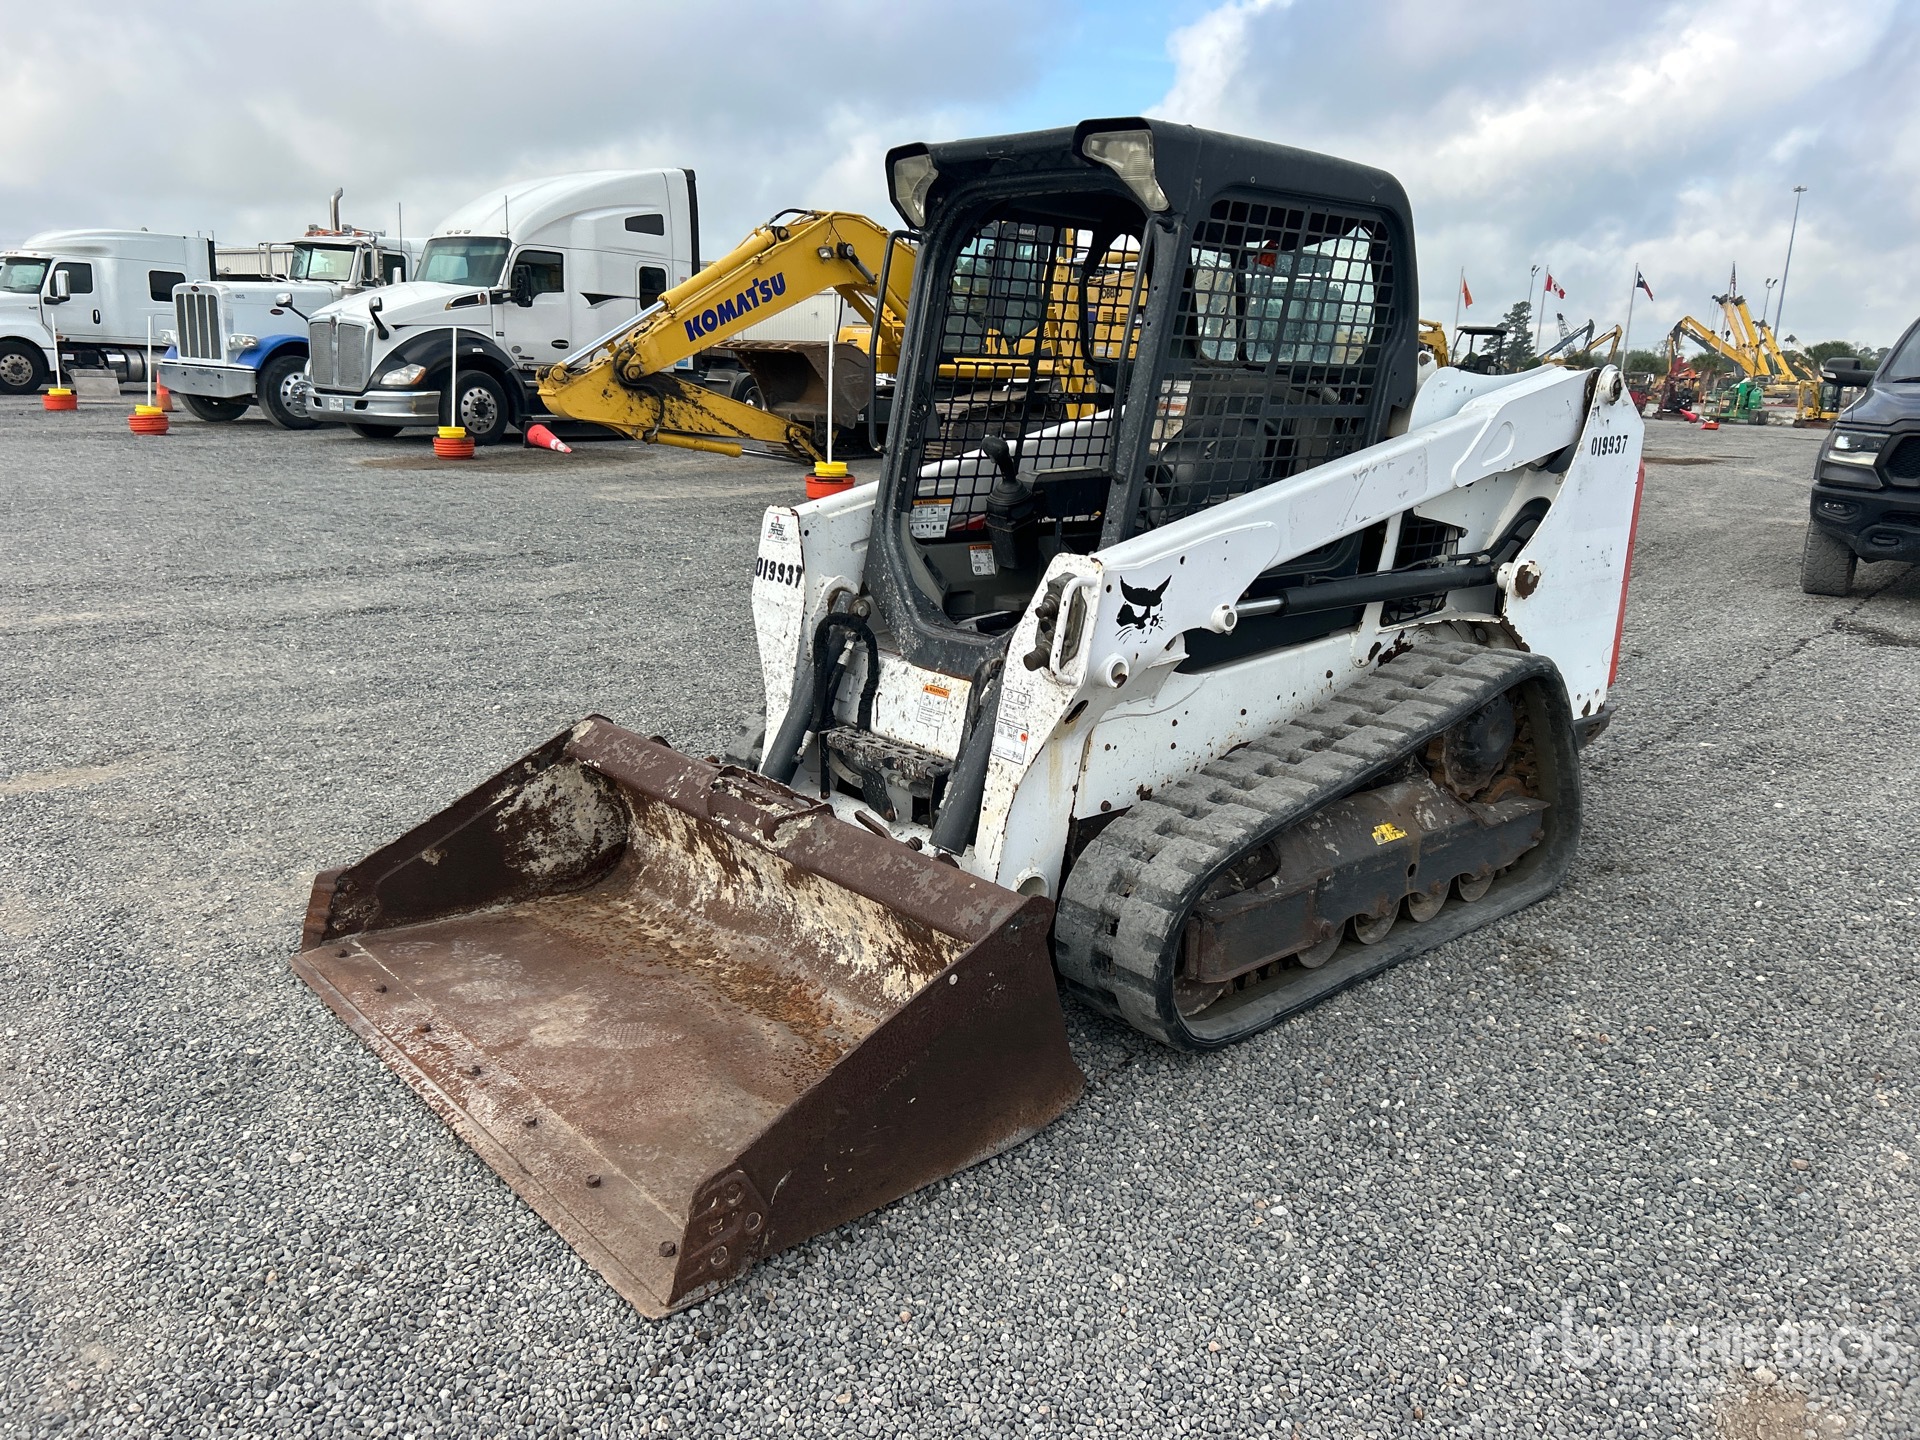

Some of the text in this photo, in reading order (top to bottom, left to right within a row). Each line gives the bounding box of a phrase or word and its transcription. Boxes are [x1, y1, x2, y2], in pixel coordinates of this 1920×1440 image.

[684, 272, 786, 342] KOMATSU
[1591, 435, 1628, 457] 019937
[755, 556, 803, 589] 019937
[929, 686, 948, 697] WARNING
